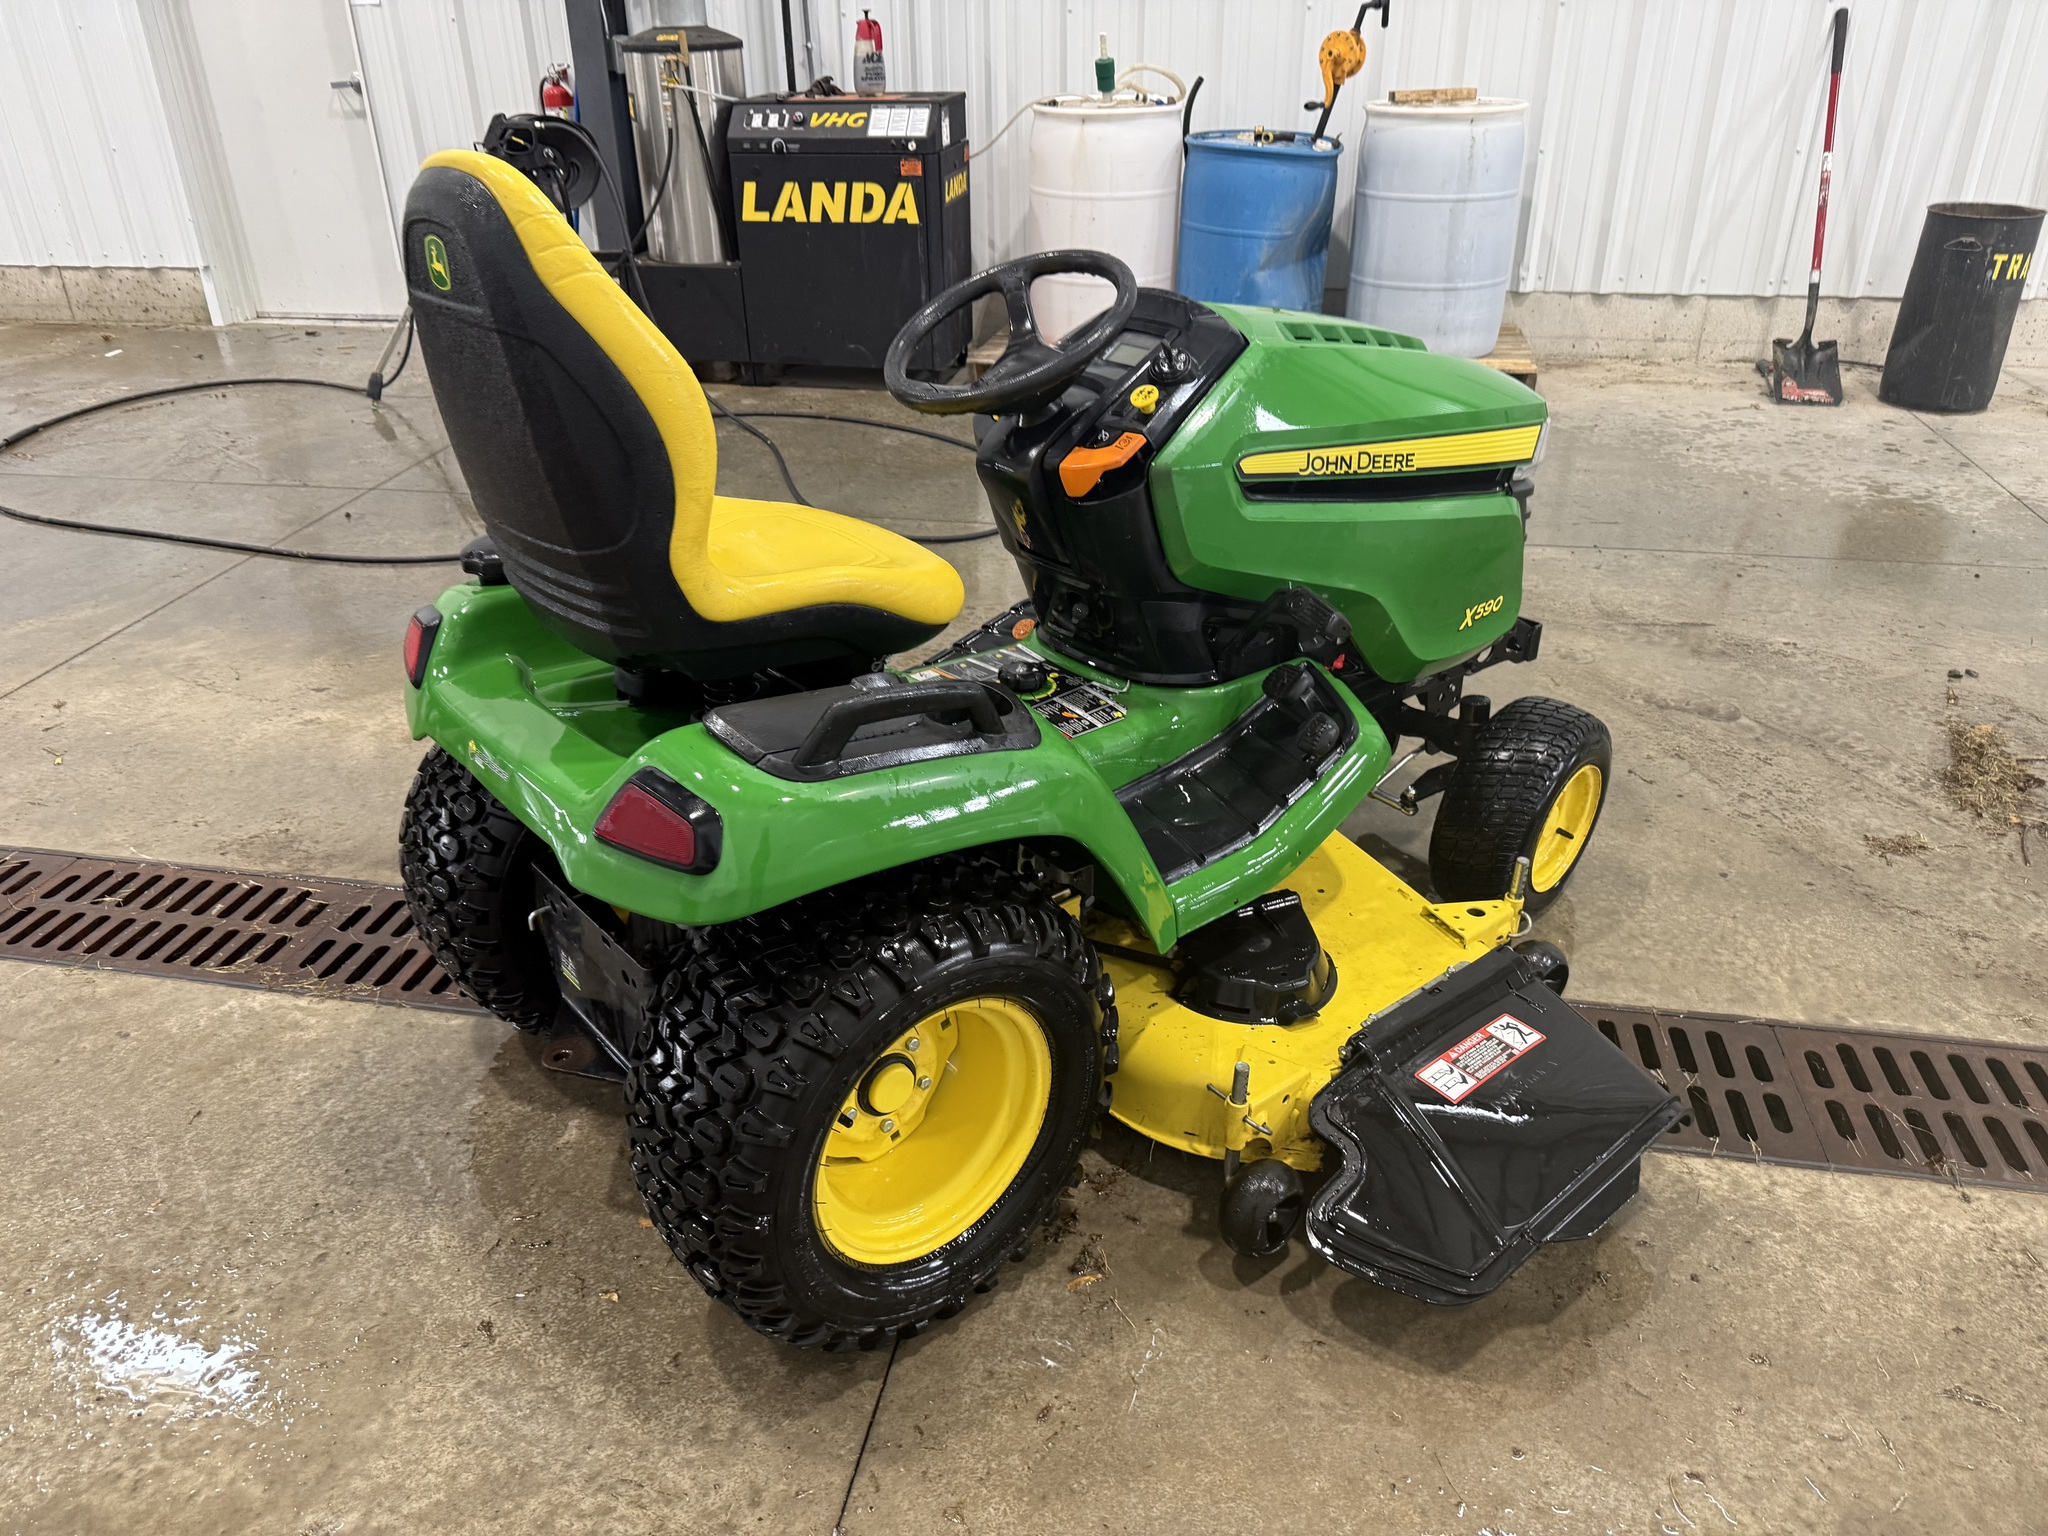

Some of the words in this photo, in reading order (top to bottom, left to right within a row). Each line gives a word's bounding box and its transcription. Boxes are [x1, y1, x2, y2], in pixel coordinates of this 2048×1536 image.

[810, 111, 867, 128] VHG
[742, 181, 920, 224] LANDA
[945, 170, 968, 203] LANDA
[1459, 595, 1504, 631] X590
[1453, 1032, 1486, 1053] DANGER
